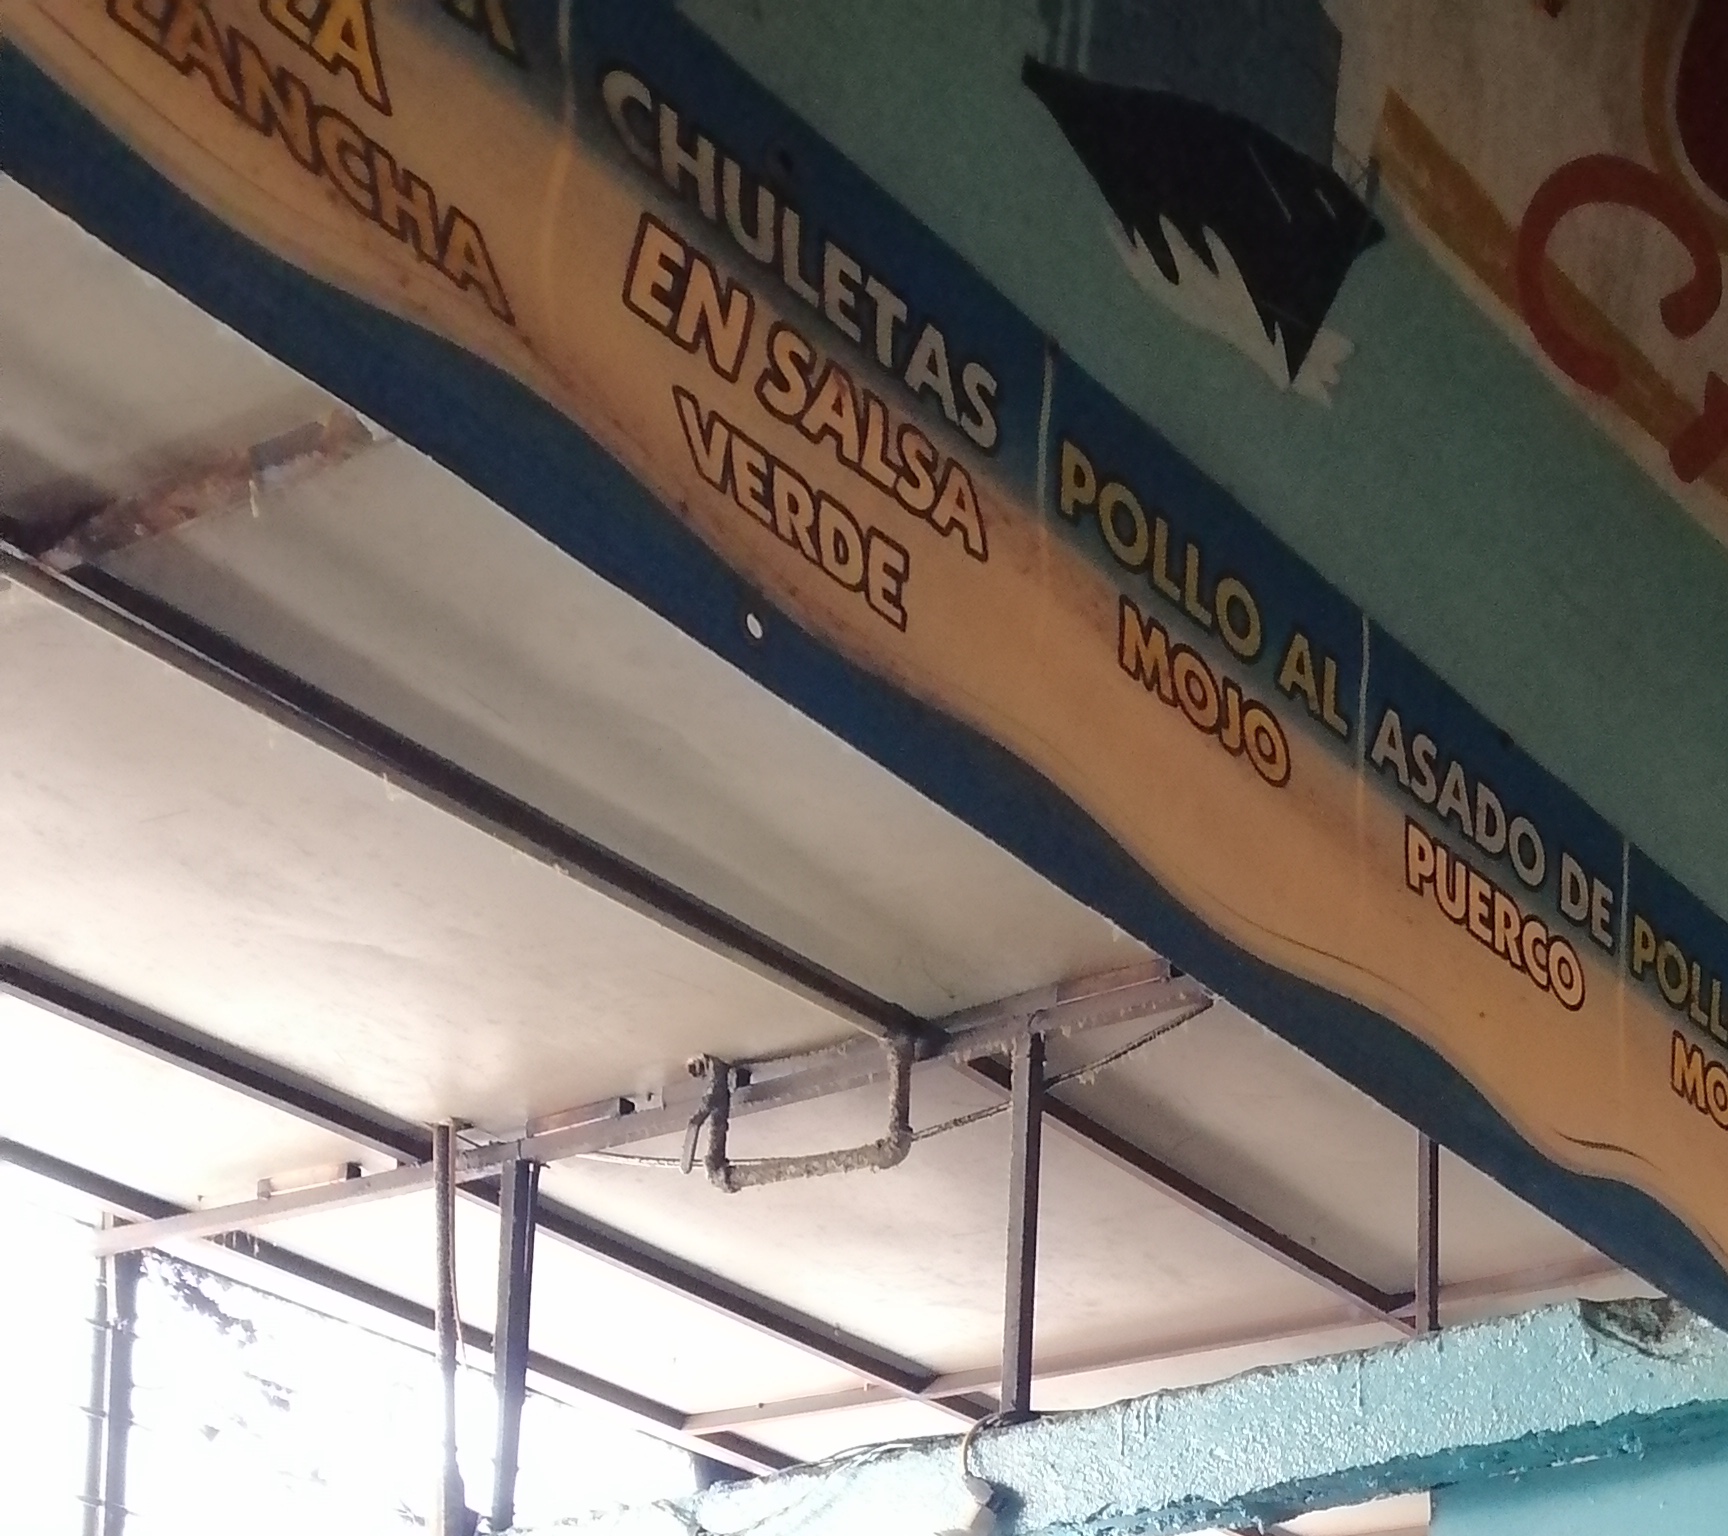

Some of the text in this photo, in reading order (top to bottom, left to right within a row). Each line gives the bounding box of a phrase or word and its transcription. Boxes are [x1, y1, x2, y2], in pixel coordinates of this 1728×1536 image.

[602, 68, 999, 449] CHULETAS
[623, 213, 988, 561] EN SALSA
[673, 385, 908, 631] VERDE
[1059, 440, 1350, 736] POLLO AL
[1118, 596, 1290, 788] MOJO
[1371, 709, 1615, 949] ASADO DE
[1405, 818, 1585, 1011] PUERCO
